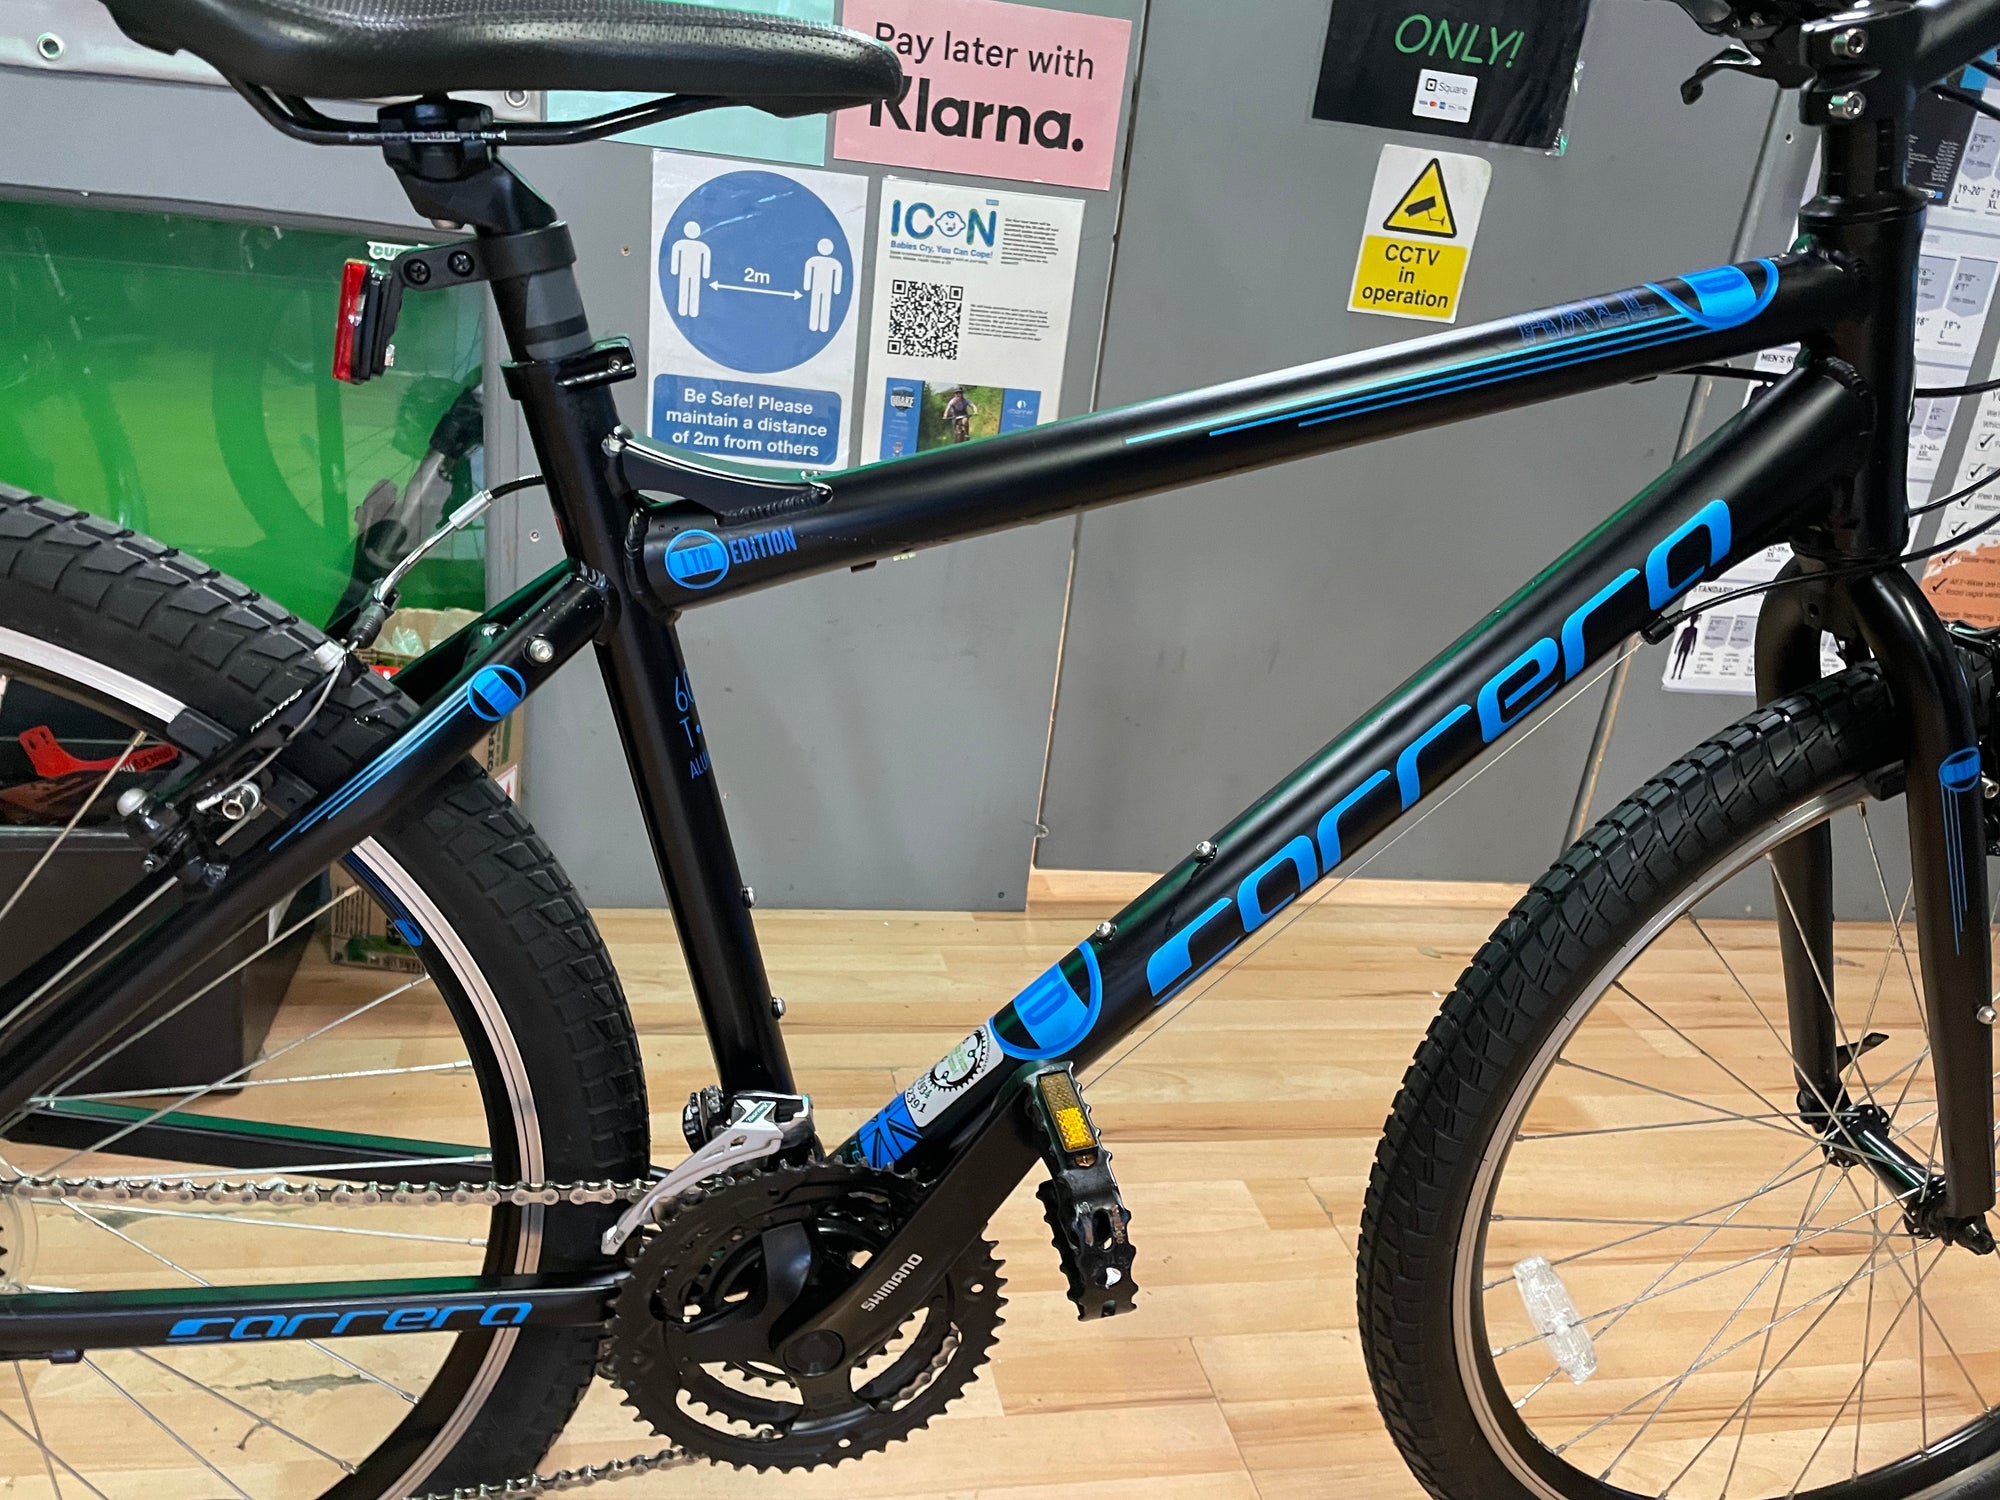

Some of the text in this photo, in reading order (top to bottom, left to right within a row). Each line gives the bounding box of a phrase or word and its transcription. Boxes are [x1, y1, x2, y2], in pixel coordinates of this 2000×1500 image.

[876, 22, 1094, 79] Pay later with
[1395, 14, 1525, 68] ONLY!
[1439, 82, 1468, 95] Square
[890, 240, 917, 252] Babies
[919, 243, 935, 255] Cry,
[937, 245, 952, 255] You
[953, 247, 969, 256] Can
[970, 249, 994, 260] Cope!
[1385, 244, 1440, 266] CCTV
[744, 267, 770, 284] 2m
[1399, 266, 1415, 284] in
[1362, 286, 1449, 308] operation
[684, 388, 813, 414] Be Safe! Please
[666, 410, 827, 437] maintain a distance
[672, 432, 819, 457] of 2m from others
[728, 526, 797, 564] EDITION
[1147, 499, 1732, 1007] carrera
[861, 1253, 923, 1311] SHIMANO
[166, 1302, 532, 1343] carrera
